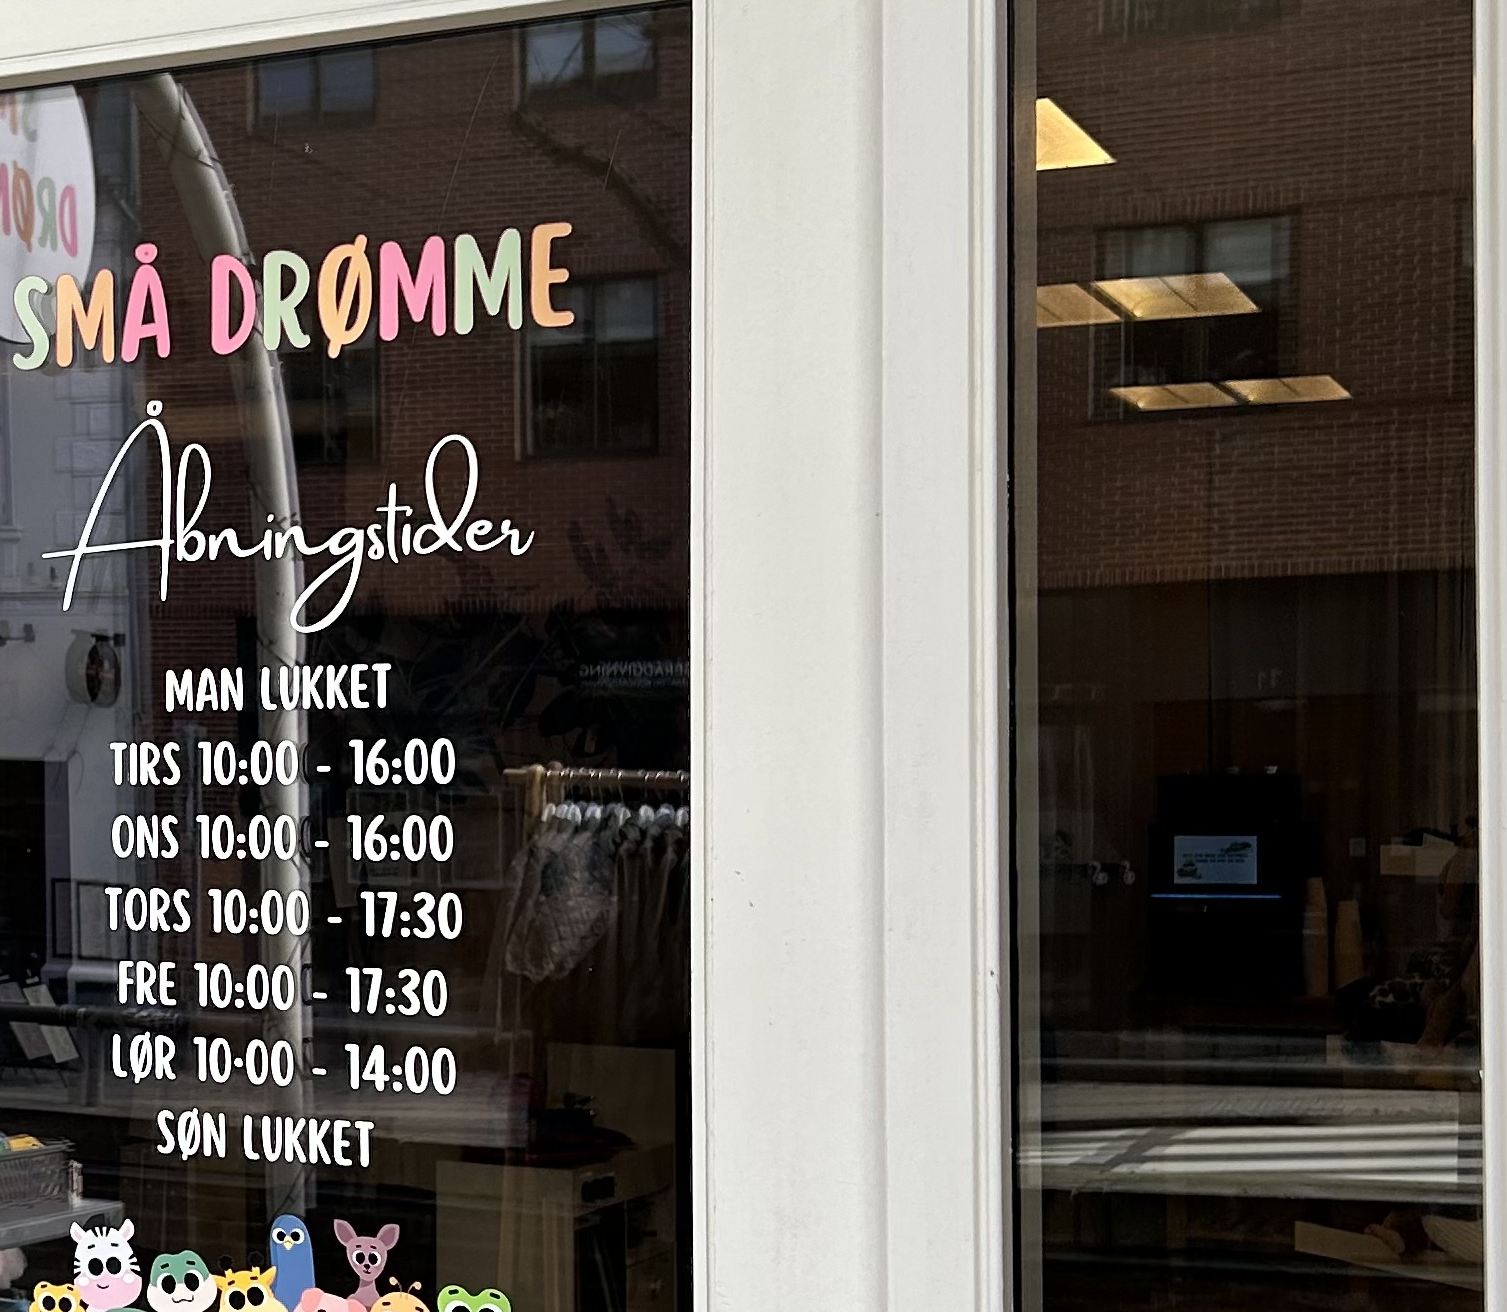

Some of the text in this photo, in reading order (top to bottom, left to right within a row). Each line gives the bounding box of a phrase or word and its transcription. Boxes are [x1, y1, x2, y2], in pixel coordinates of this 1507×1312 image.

[11, 222, 576, 371] SMÅ DRØMME
[41, 400, 535, 634] Åbningstider
[165, 663, 392, 713] MAN LUKKET
[109, 741, 181, 786] TIRS
[197, 740, 299, 786] 10:00
[348, 737, 456, 786] 16:00
[111, 814, 179, 859] ONS
[195, 814, 297, 861] 10:00
[347, 814, 454, 862] 16:00
[104, 887, 191, 933] TORS
[208, 888, 310, 936] 10:00
[360, 891, 463, 940] 17:30
[118, 960, 177, 1006] FRE
[193, 962, 295, 1011] 10:00
[345, 967, 448, 1017] 17:30
[112, 1031, 177, 1084] LØR
[344, 1043, 456, 1095] 14:00
[156, 1107, 375, 1168] SØN LUKKET
